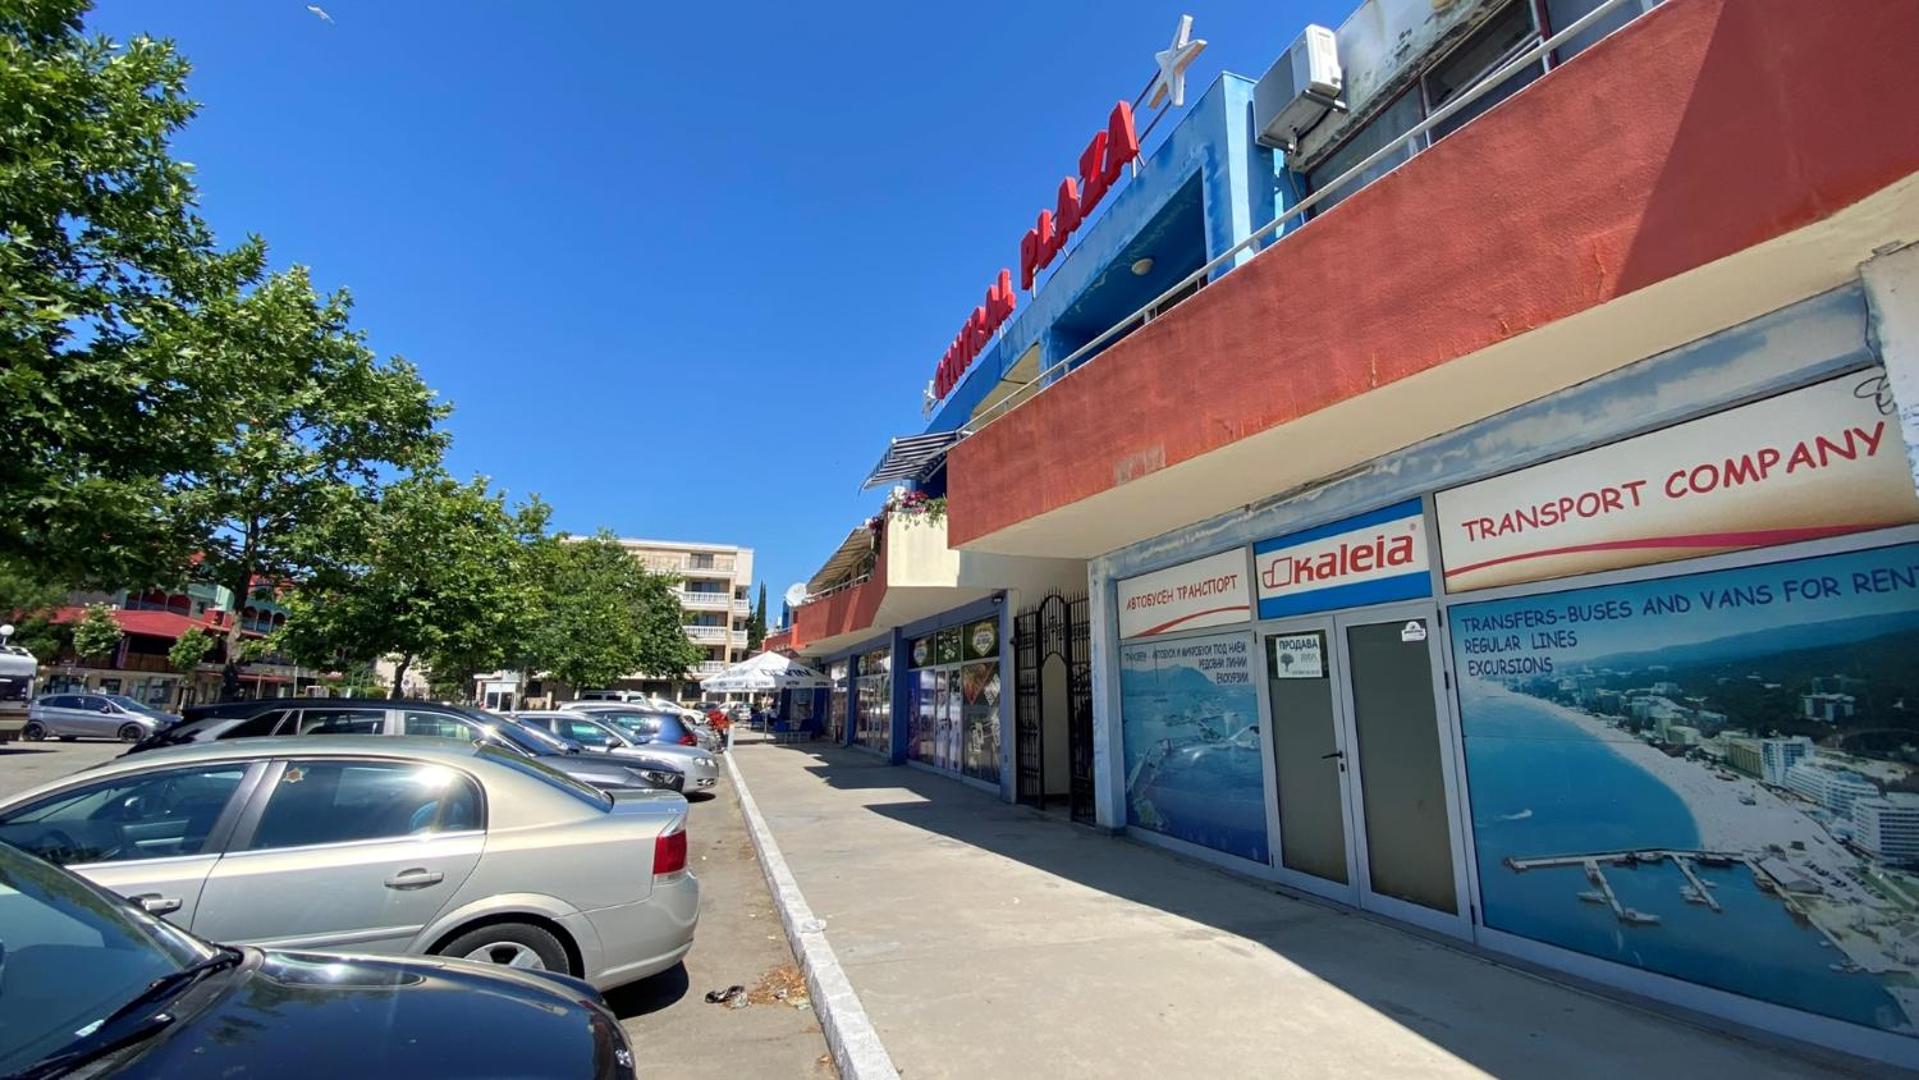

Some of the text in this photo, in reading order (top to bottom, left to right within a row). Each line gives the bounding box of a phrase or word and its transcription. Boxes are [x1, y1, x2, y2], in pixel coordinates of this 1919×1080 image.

[1020, 99, 1139, 290] PLAZA
[1461, 421, 1885, 543] TRANSPORT COMPANY
[1293, 534, 1415, 584] kaleia
[1126, 574, 1238, 611] АВТОБУСЕН ТРАНСПОРТ
[1461, 600, 1632, 633] TRANSFERS-BUSES
[1643, 594, 1691, 616] AND
[1700, 584, 1773, 610] VANS
[1783, 576, 1841, 602] FOR
[1279, 638, 1319, 651] ПРОДАВА
[1464, 630, 1578, 654] REGULAR LINES
[1468, 657, 1554, 677] EXCURSIONS
